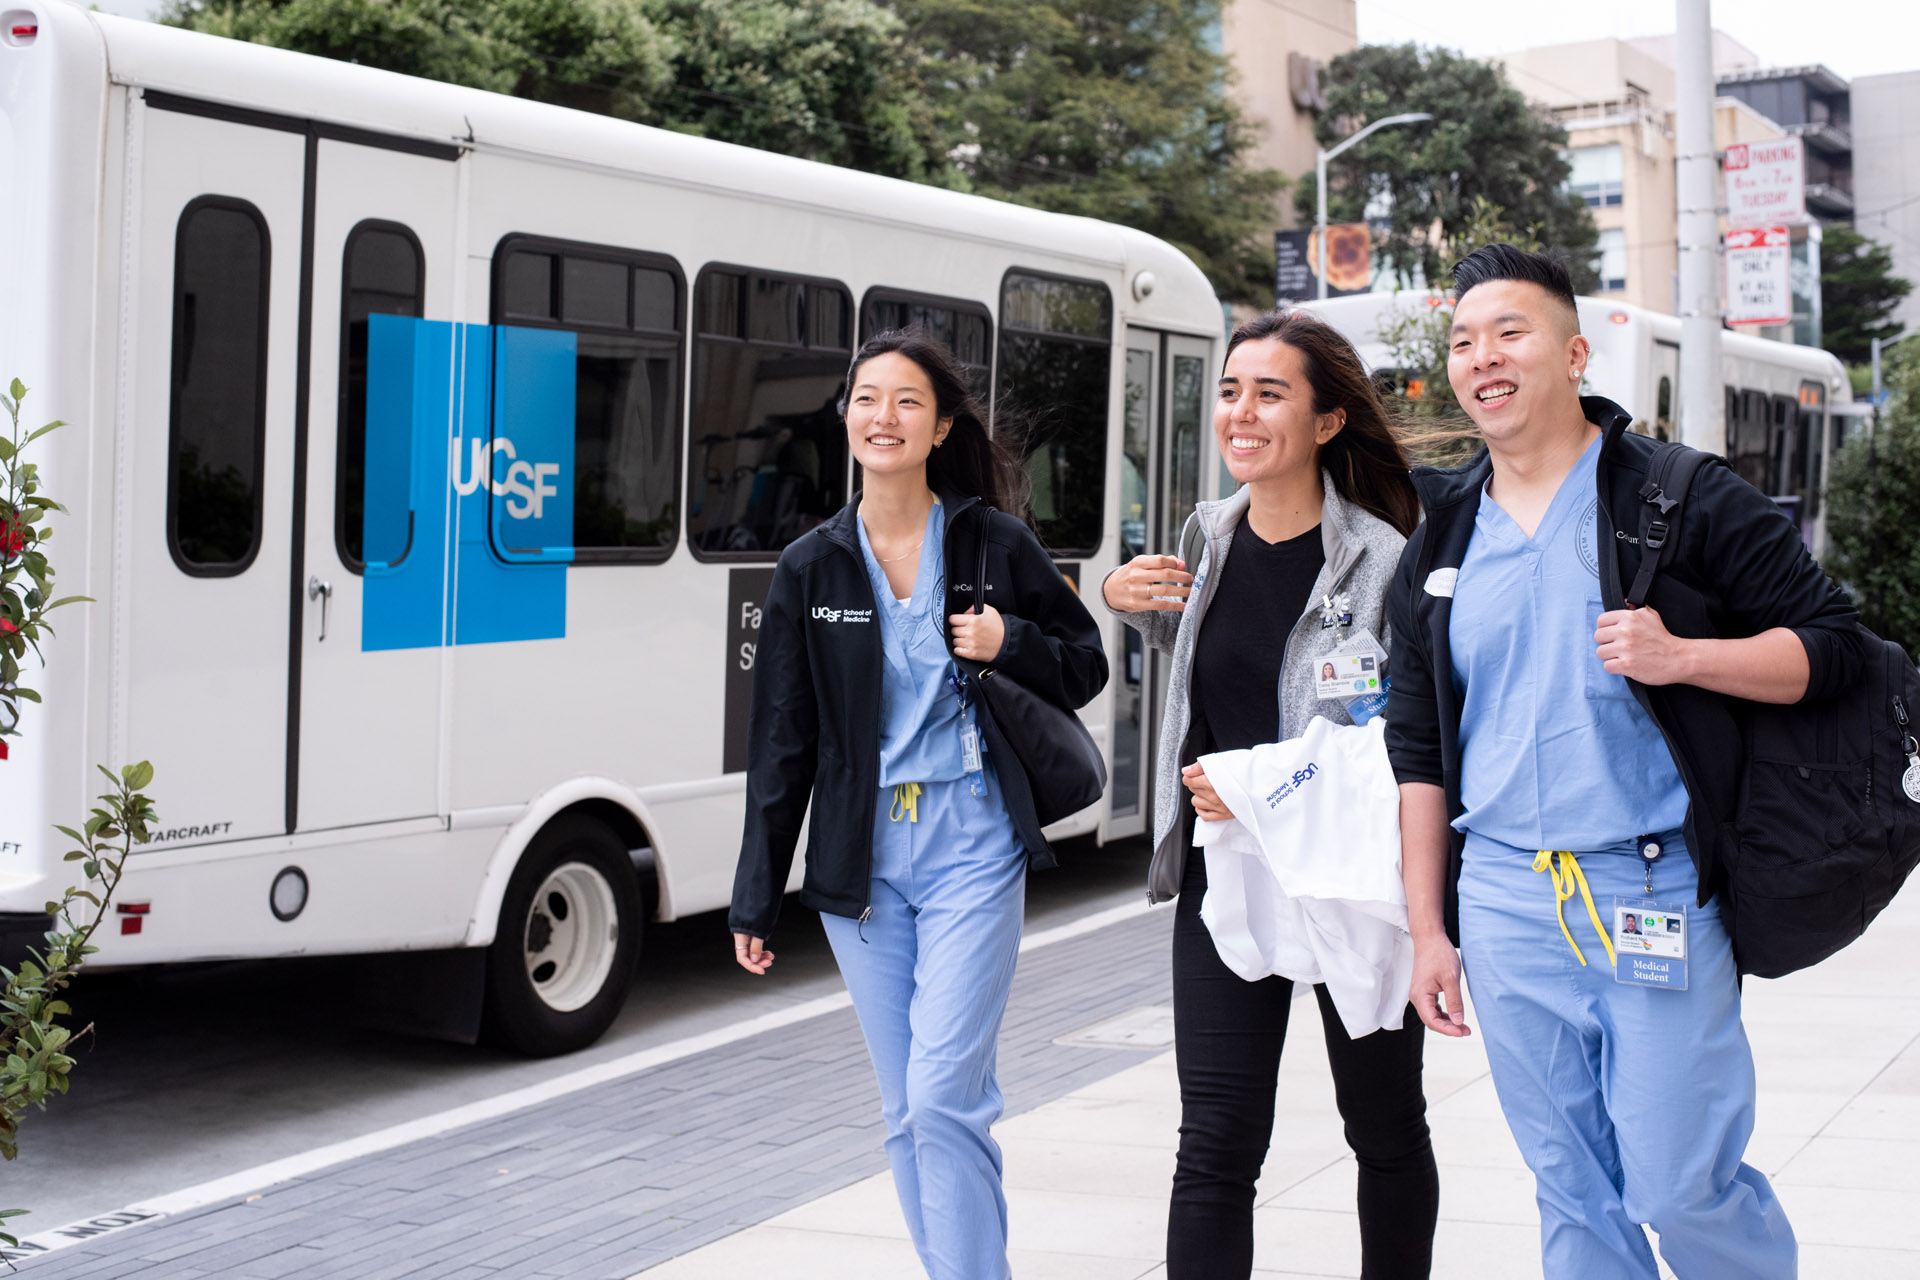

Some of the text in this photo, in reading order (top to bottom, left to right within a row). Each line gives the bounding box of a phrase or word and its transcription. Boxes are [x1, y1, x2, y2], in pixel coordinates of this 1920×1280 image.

[1726, 146, 1795, 169] NO PARKING
[1741, 191, 1788, 208] TUESDAY
[1743, 261, 1771, 273] ONLY
[1739, 280, 1775, 291] AT ALL
[1742, 293, 1773, 305] TIMES
[453, 437, 559, 519] UCSF
[1582, 537, 1598, 568] SYSTEM
[812, 607, 841, 622] UCSF
[1292, 763, 1318, 788] UCSF
[1266, 782, 1289, 802] Medicine
[1275, 787, 1293, 804] School
[1633, 960, 1669, 972] Medical
[1633, 970, 1669, 982] Student
[54, 1212, 159, 1239] TOW
